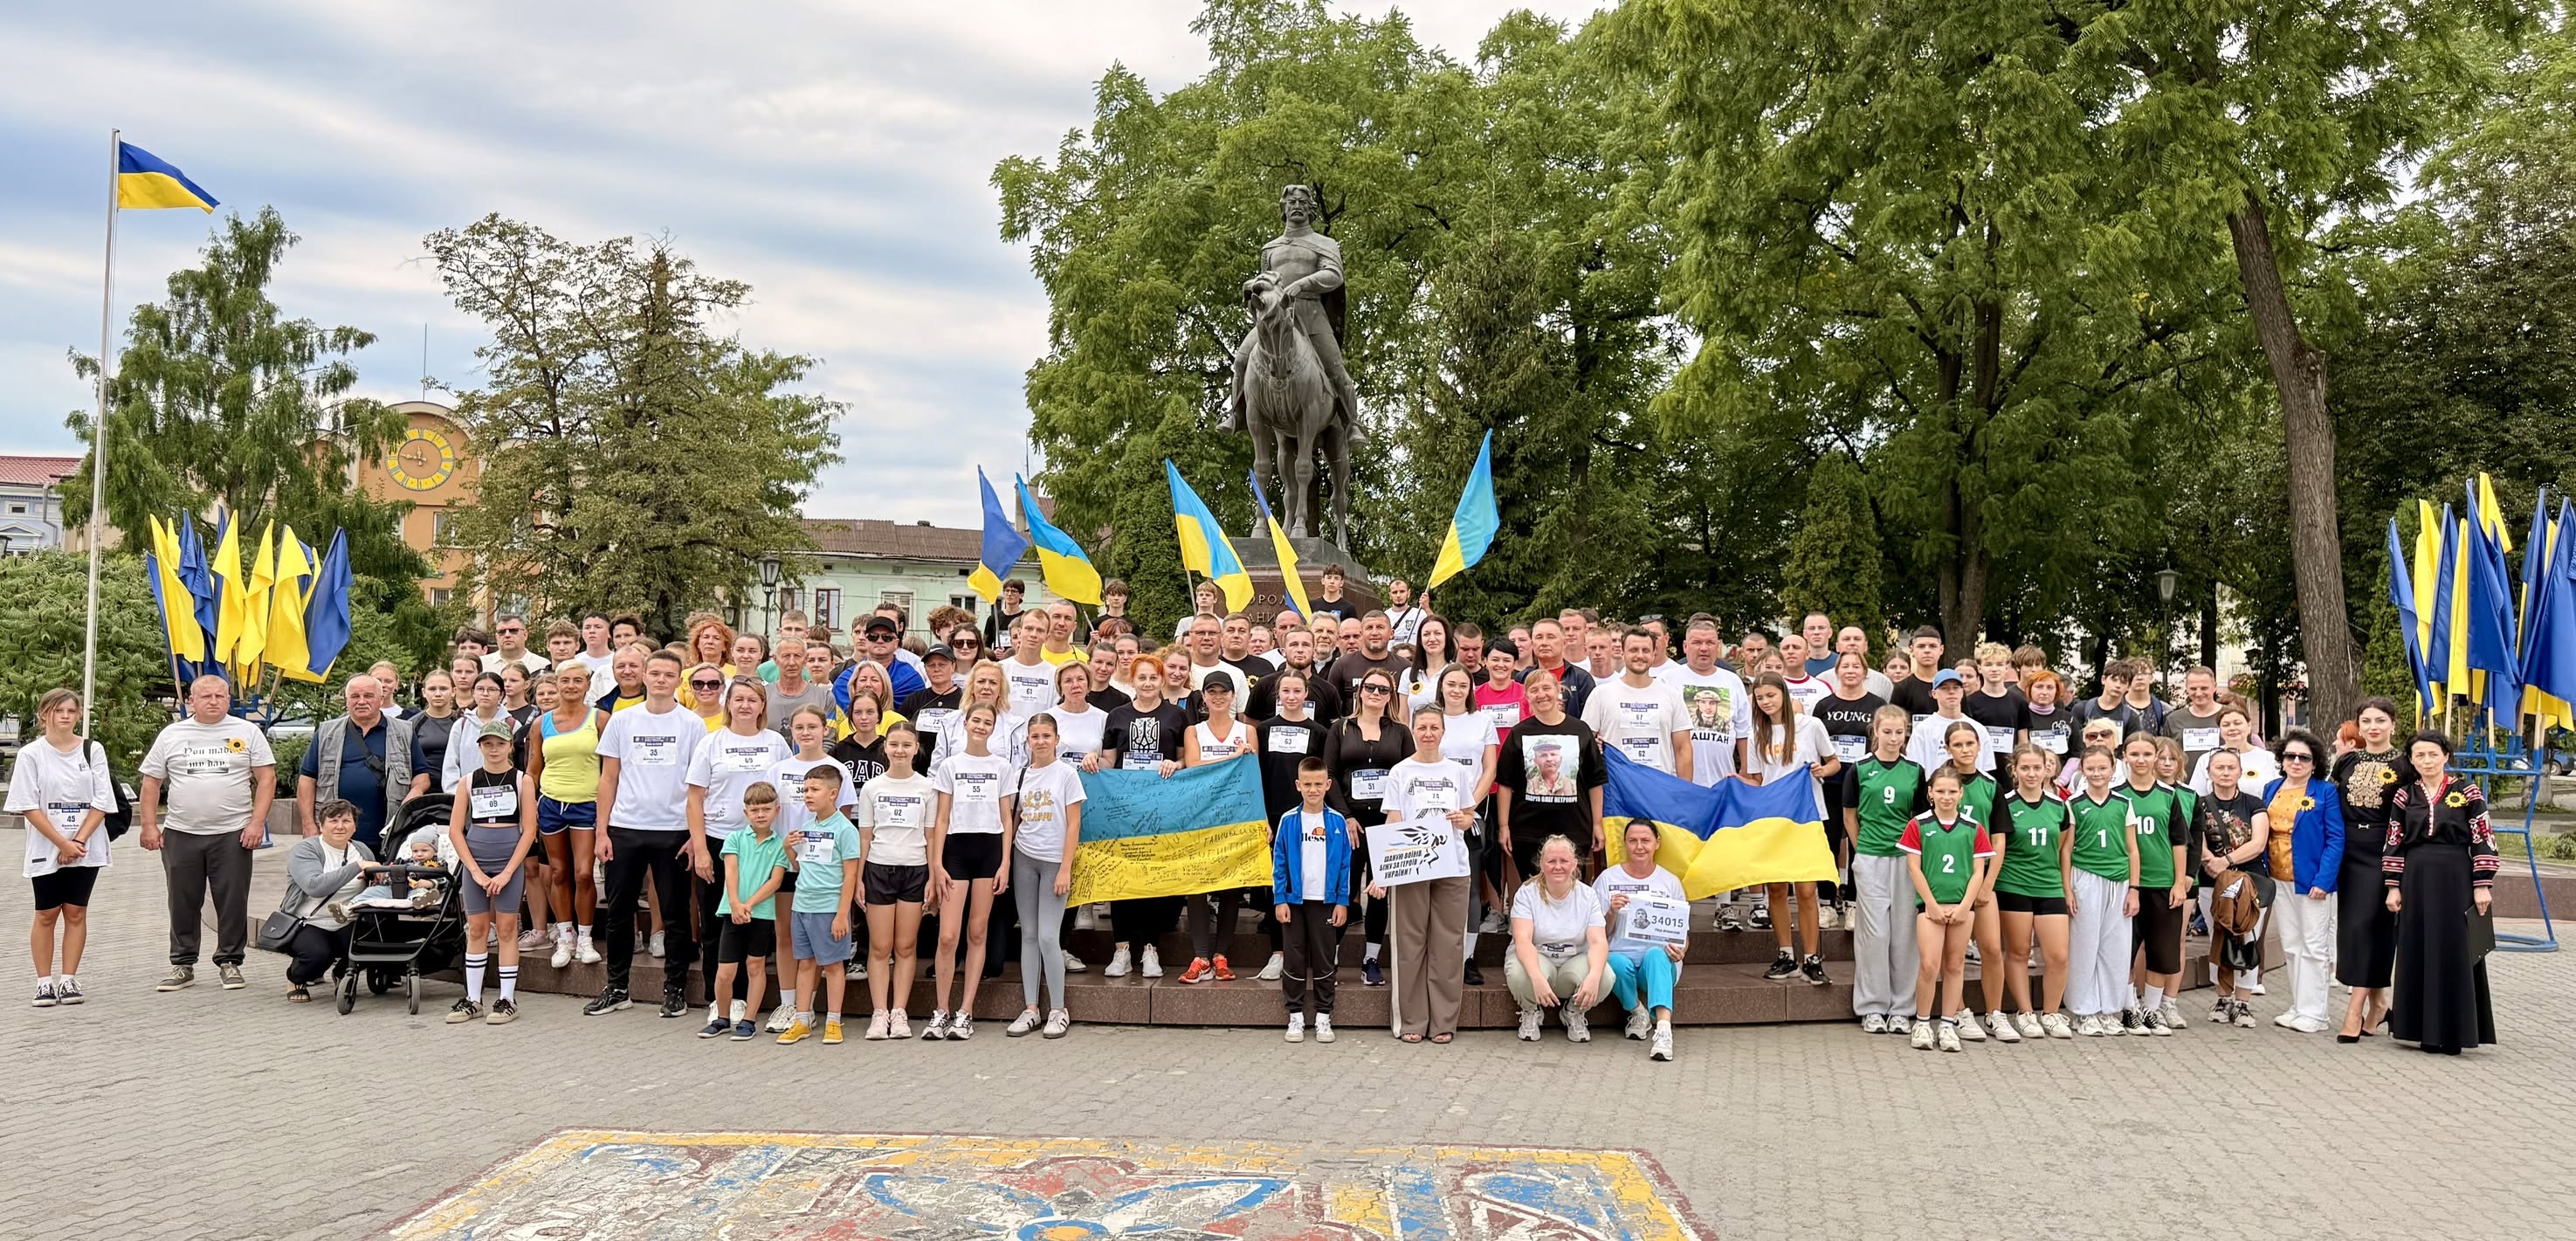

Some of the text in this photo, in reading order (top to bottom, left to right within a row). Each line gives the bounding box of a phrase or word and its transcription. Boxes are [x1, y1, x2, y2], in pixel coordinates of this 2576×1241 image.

[1827, 711, 1871, 723] YOUNG
[1691, 732, 1730, 745] АШТАН
[1884, 786, 1896, 804] 9
[2136, 816, 2154, 834] 10
[2028, 828, 2047, 846] 11
[2097, 830, 2107, 848] 1
[1942, 854, 1954, 873] 2
[1651, 915, 1684, 928] 34015
